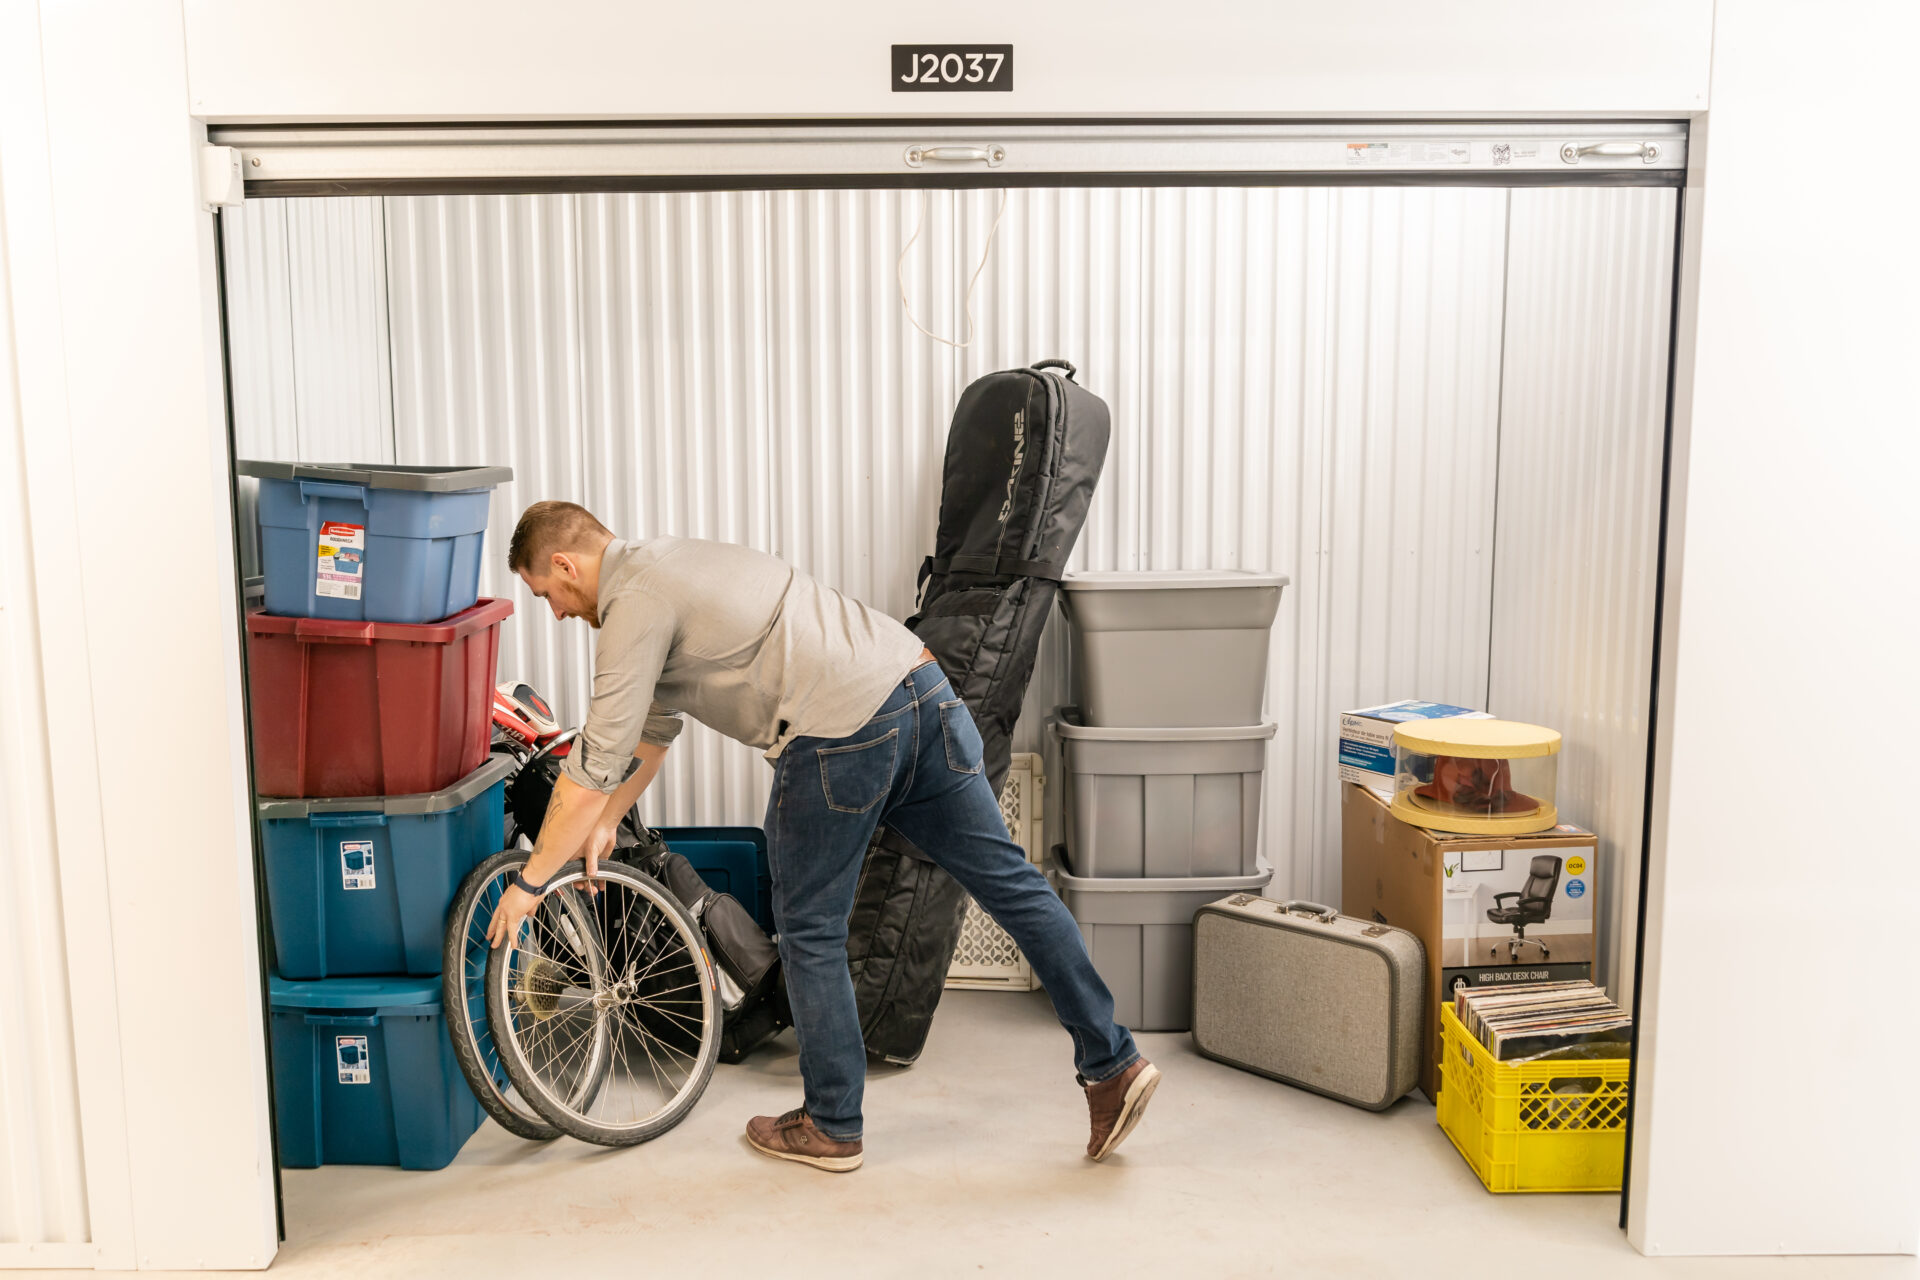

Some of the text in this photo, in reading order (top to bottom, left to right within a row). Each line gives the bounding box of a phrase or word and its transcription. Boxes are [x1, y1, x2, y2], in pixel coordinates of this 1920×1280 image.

[901, 53, 1004, 83] J2037
[1479, 970, 1549, 982] HIGH BACK DESK CHAIR
